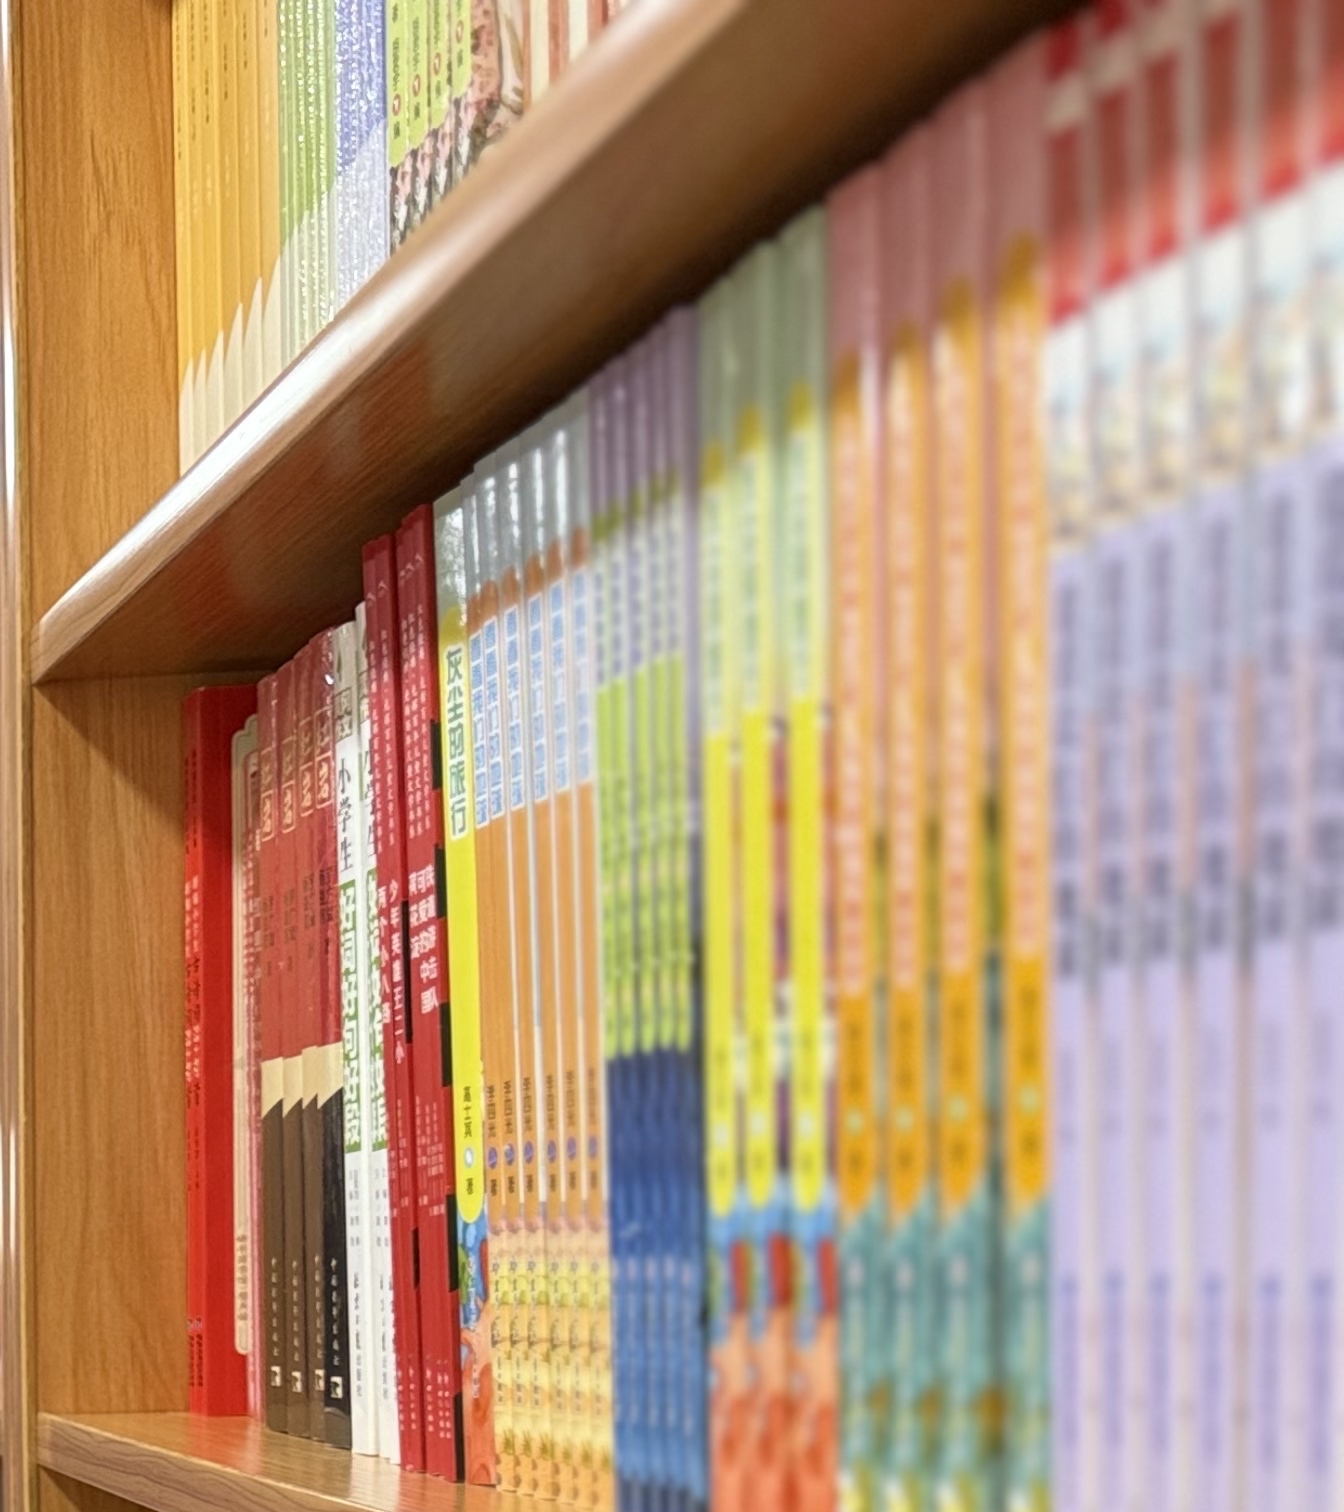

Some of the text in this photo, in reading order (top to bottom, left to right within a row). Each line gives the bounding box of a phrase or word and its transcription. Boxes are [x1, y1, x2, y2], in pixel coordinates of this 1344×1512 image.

[338, 757, 353, 871] 小学生
[446, 648, 466, 836] 灰尘的旅行
[340, 886, 361, 1145] 好词好句好段
[389, 879, 405, 1064] 少年英雄王二小
